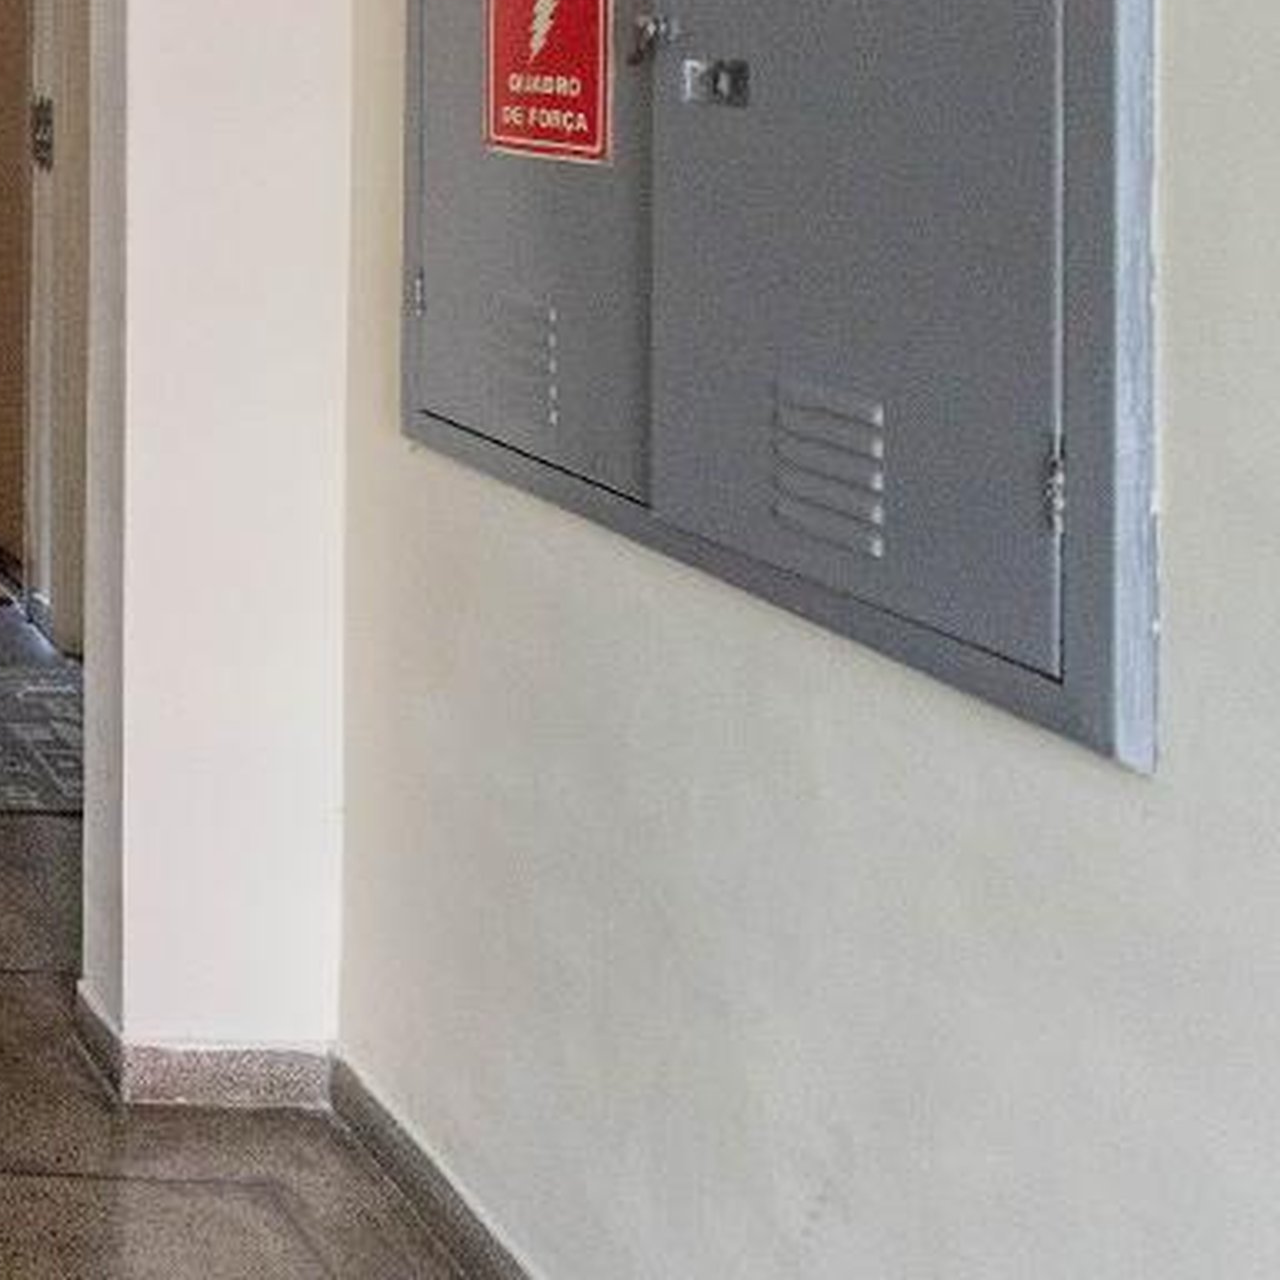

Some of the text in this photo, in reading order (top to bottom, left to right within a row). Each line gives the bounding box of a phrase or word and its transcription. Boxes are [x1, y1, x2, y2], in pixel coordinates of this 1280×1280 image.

[508, 73, 581, 97] QUADRO
[502, 106, 589, 133] DE FORÇA
